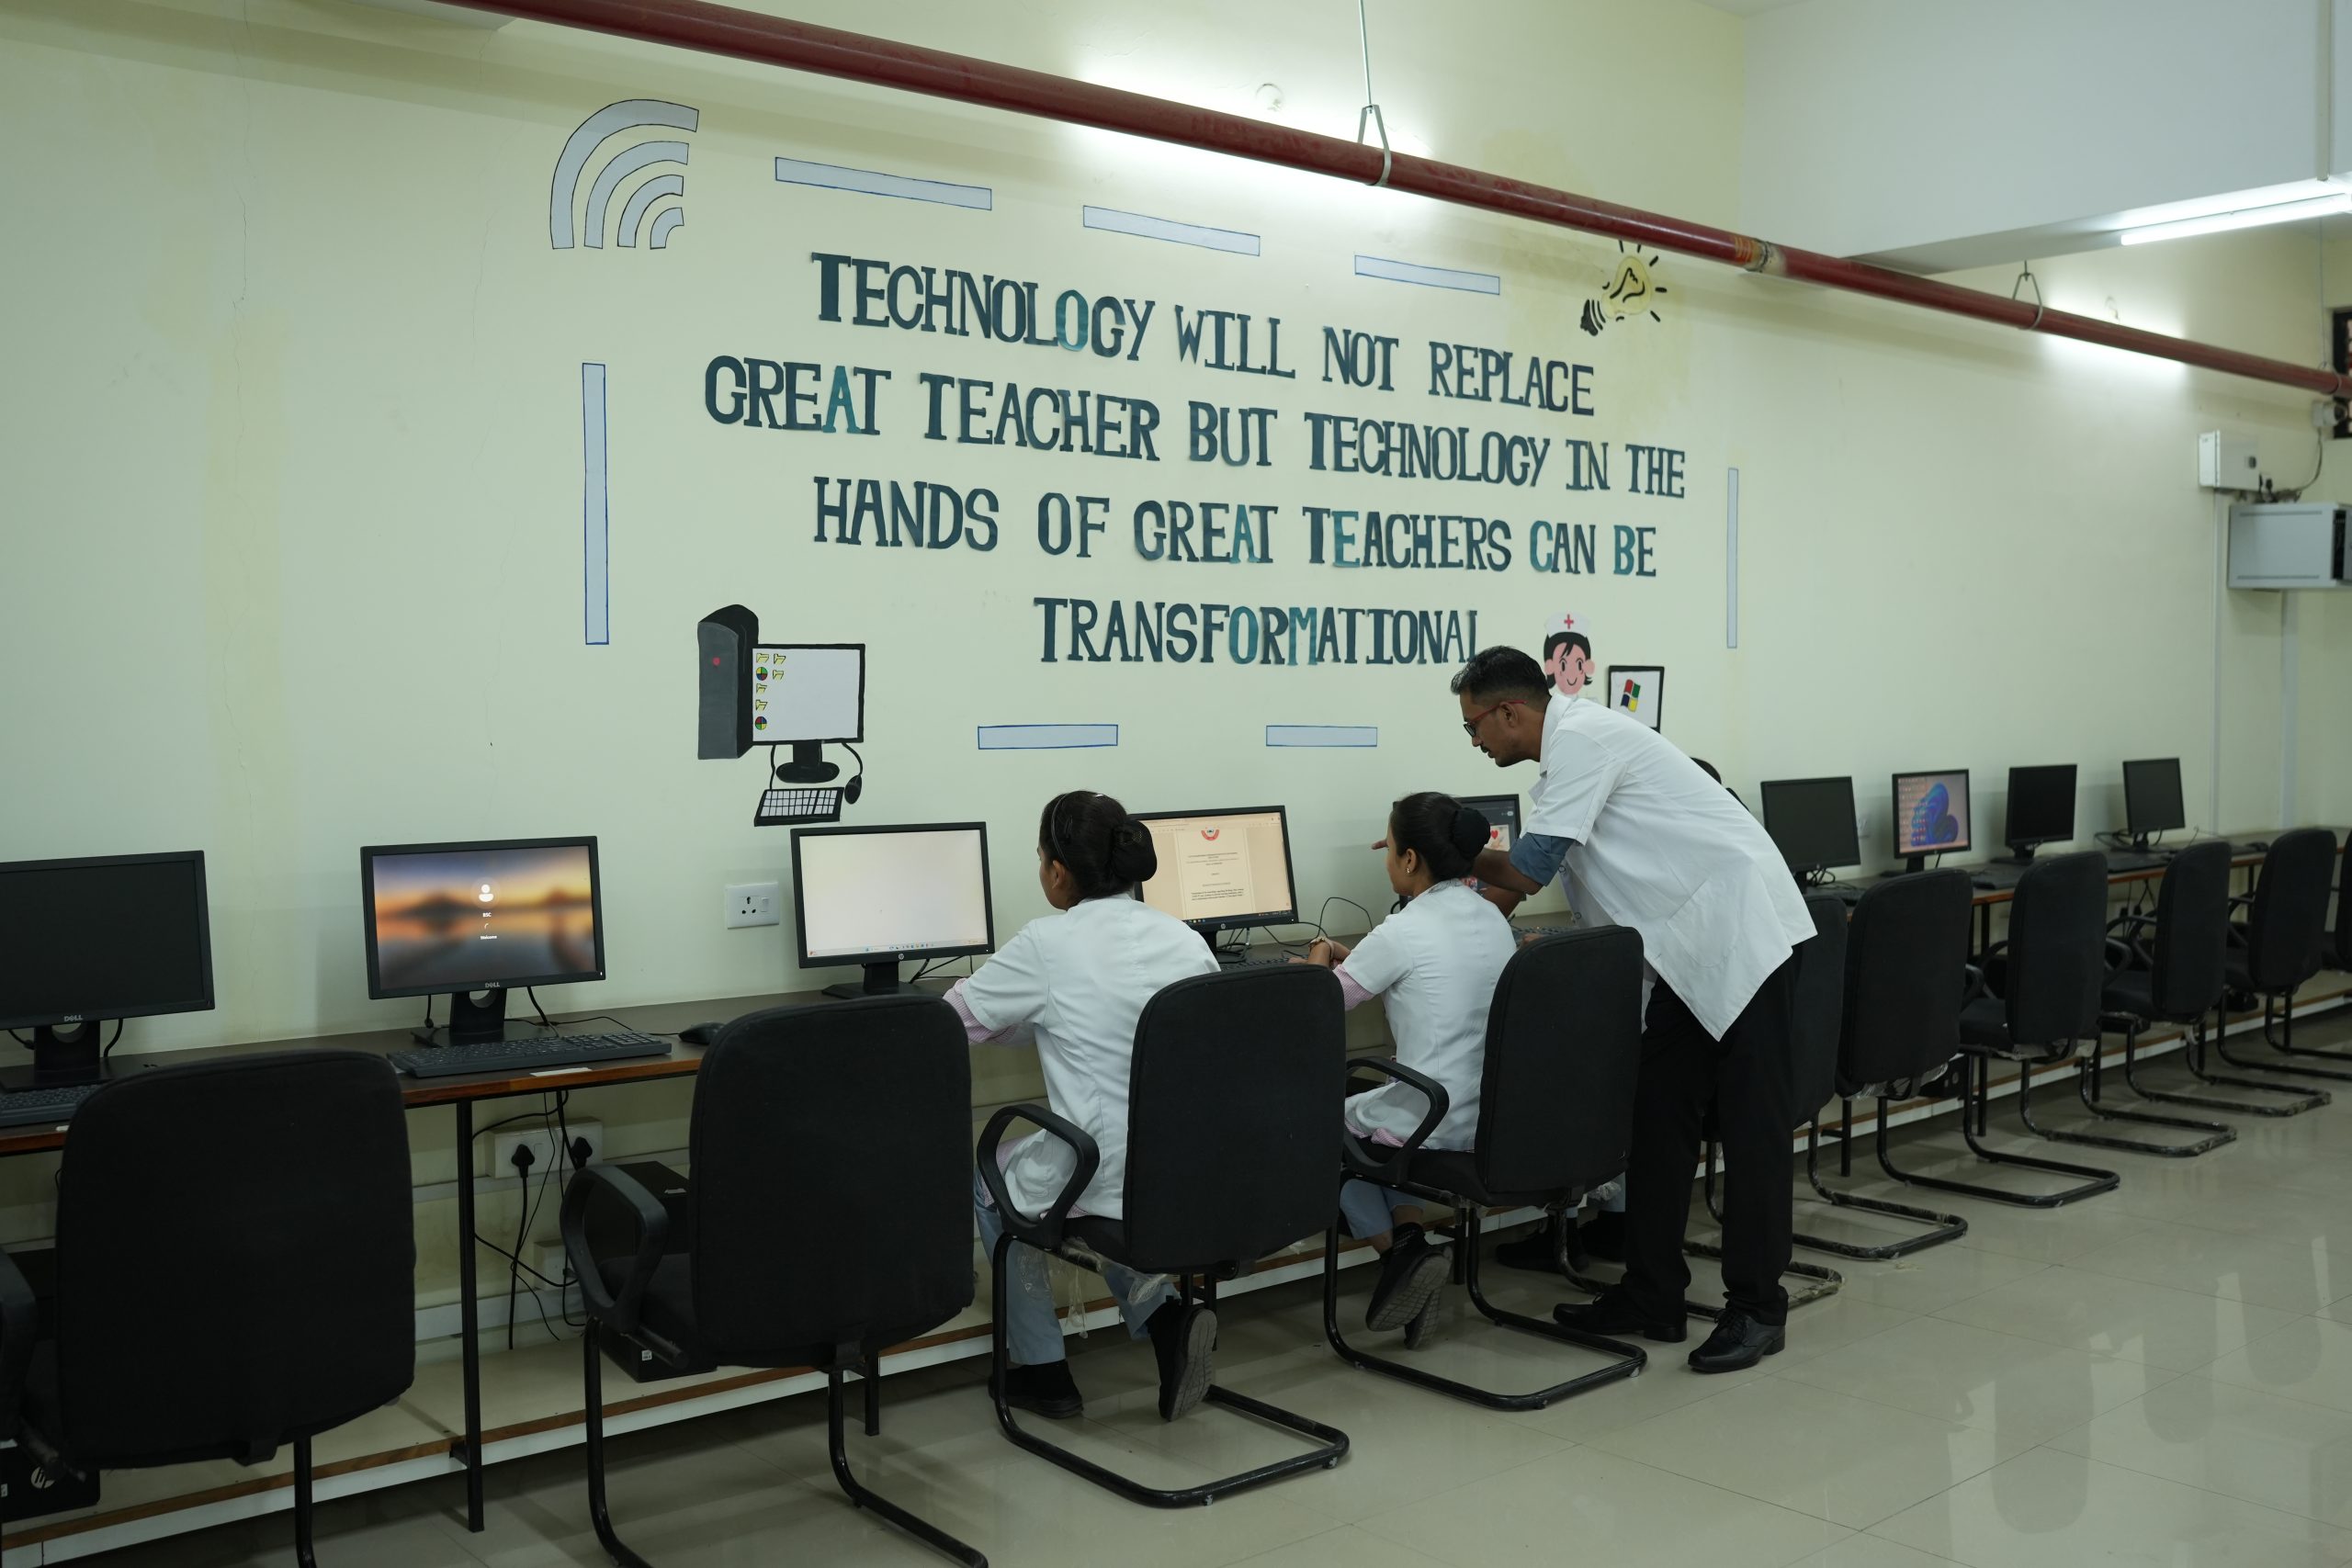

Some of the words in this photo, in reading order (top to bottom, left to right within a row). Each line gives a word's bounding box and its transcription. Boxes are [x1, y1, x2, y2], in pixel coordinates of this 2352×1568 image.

[811, 252, 1156, 362] TECHNOLOGY
[1174, 304, 1296, 379] WILL
[1322, 326, 1399, 392] NOT
[1428, 341, 1595, 417] REPLACE
[705, 355, 892, 436] GREAT
[919, 372, 1160, 462] TEACHER
[1188, 400, 1278, 468] BUT
[1304, 412, 1551, 488] TECHNOLOGY
[1565, 438, 1611, 491] IN
[1624, 444, 1686, 500] THE
[813, 476, 1000, 552] HANDS
[1037, 491, 1110, 558] OF
[1133, 500, 1279, 565] GREAT
[1302, 506, 1512, 572] TEACHERS
[1529, 520, 1597, 575] CAN
[1612, 525, 1657, 578] BE
[63, 1014, 84, 1022] DELL
